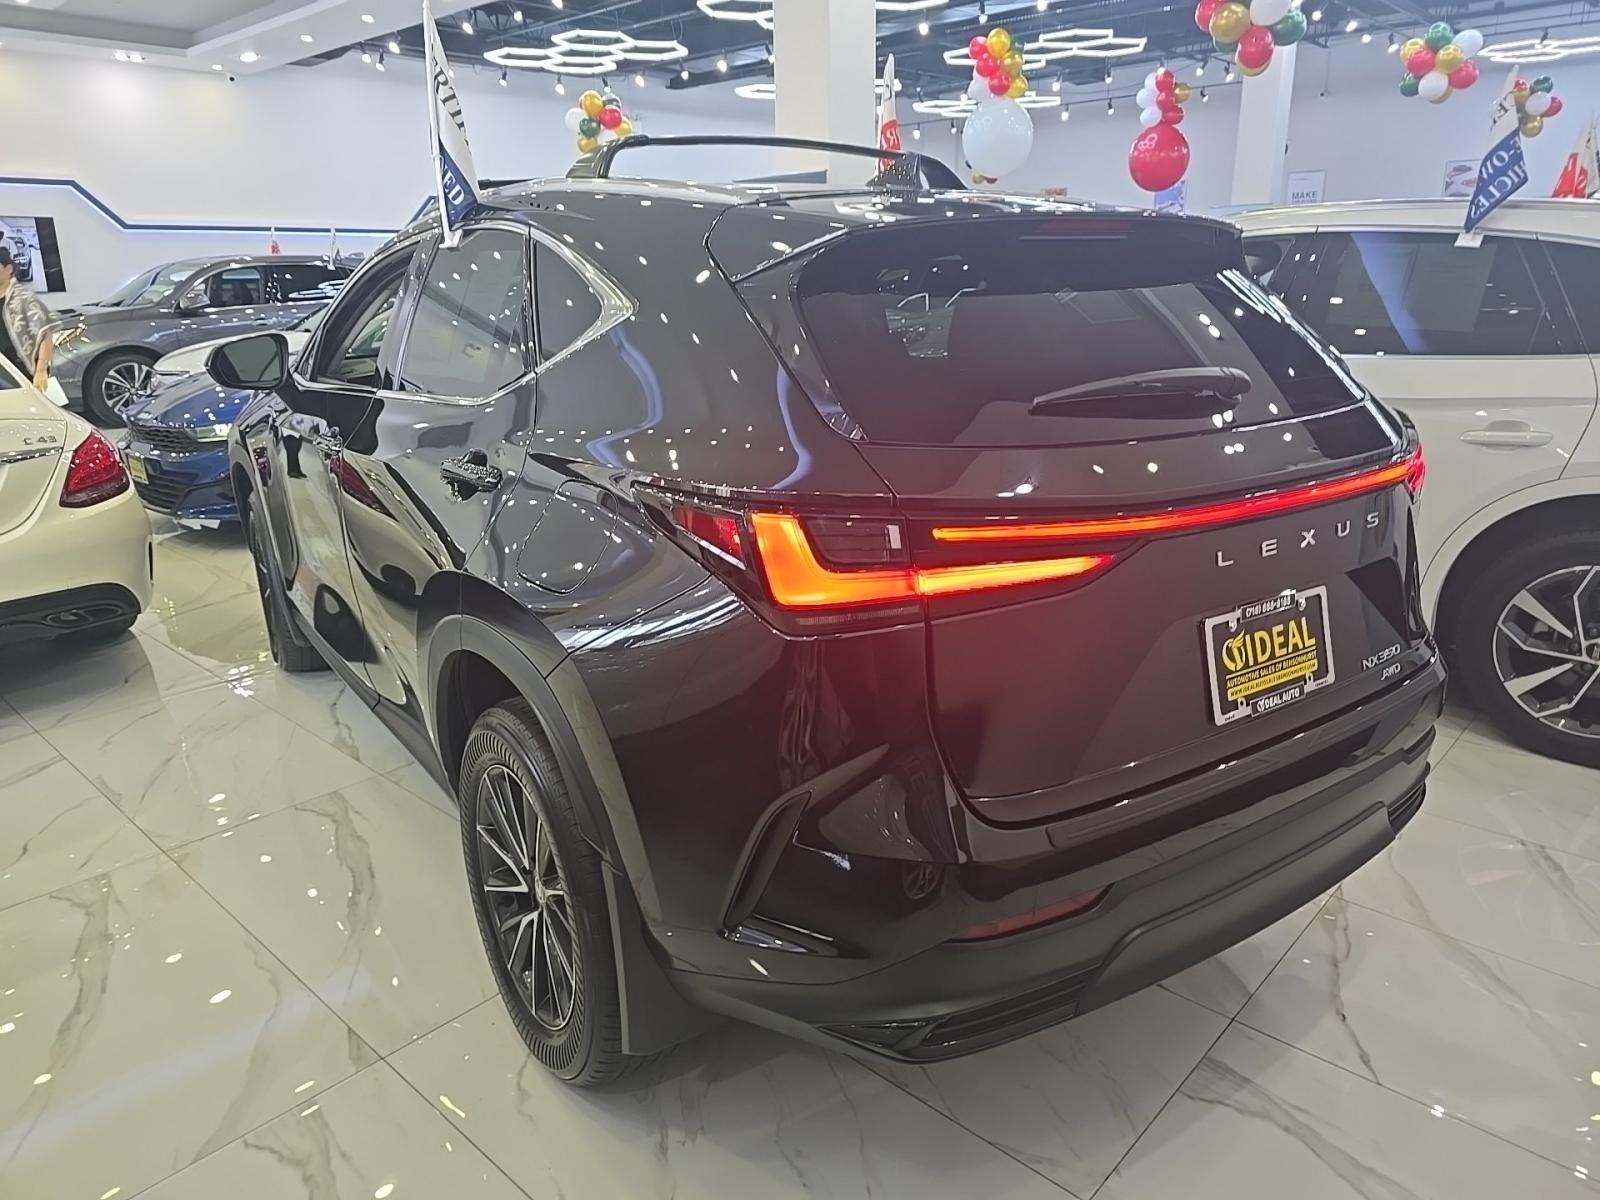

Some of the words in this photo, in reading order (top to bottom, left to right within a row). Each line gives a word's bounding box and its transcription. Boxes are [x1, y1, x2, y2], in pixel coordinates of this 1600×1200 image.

[1292, 191, 1318, 200] MAKE
[1216, 511, 1379, 567] LEXUS
[1244, 616, 1316, 668] IDEAL
[1380, 662, 1401, 681] AWD
[1282, 687, 1300, 703] AUTO
